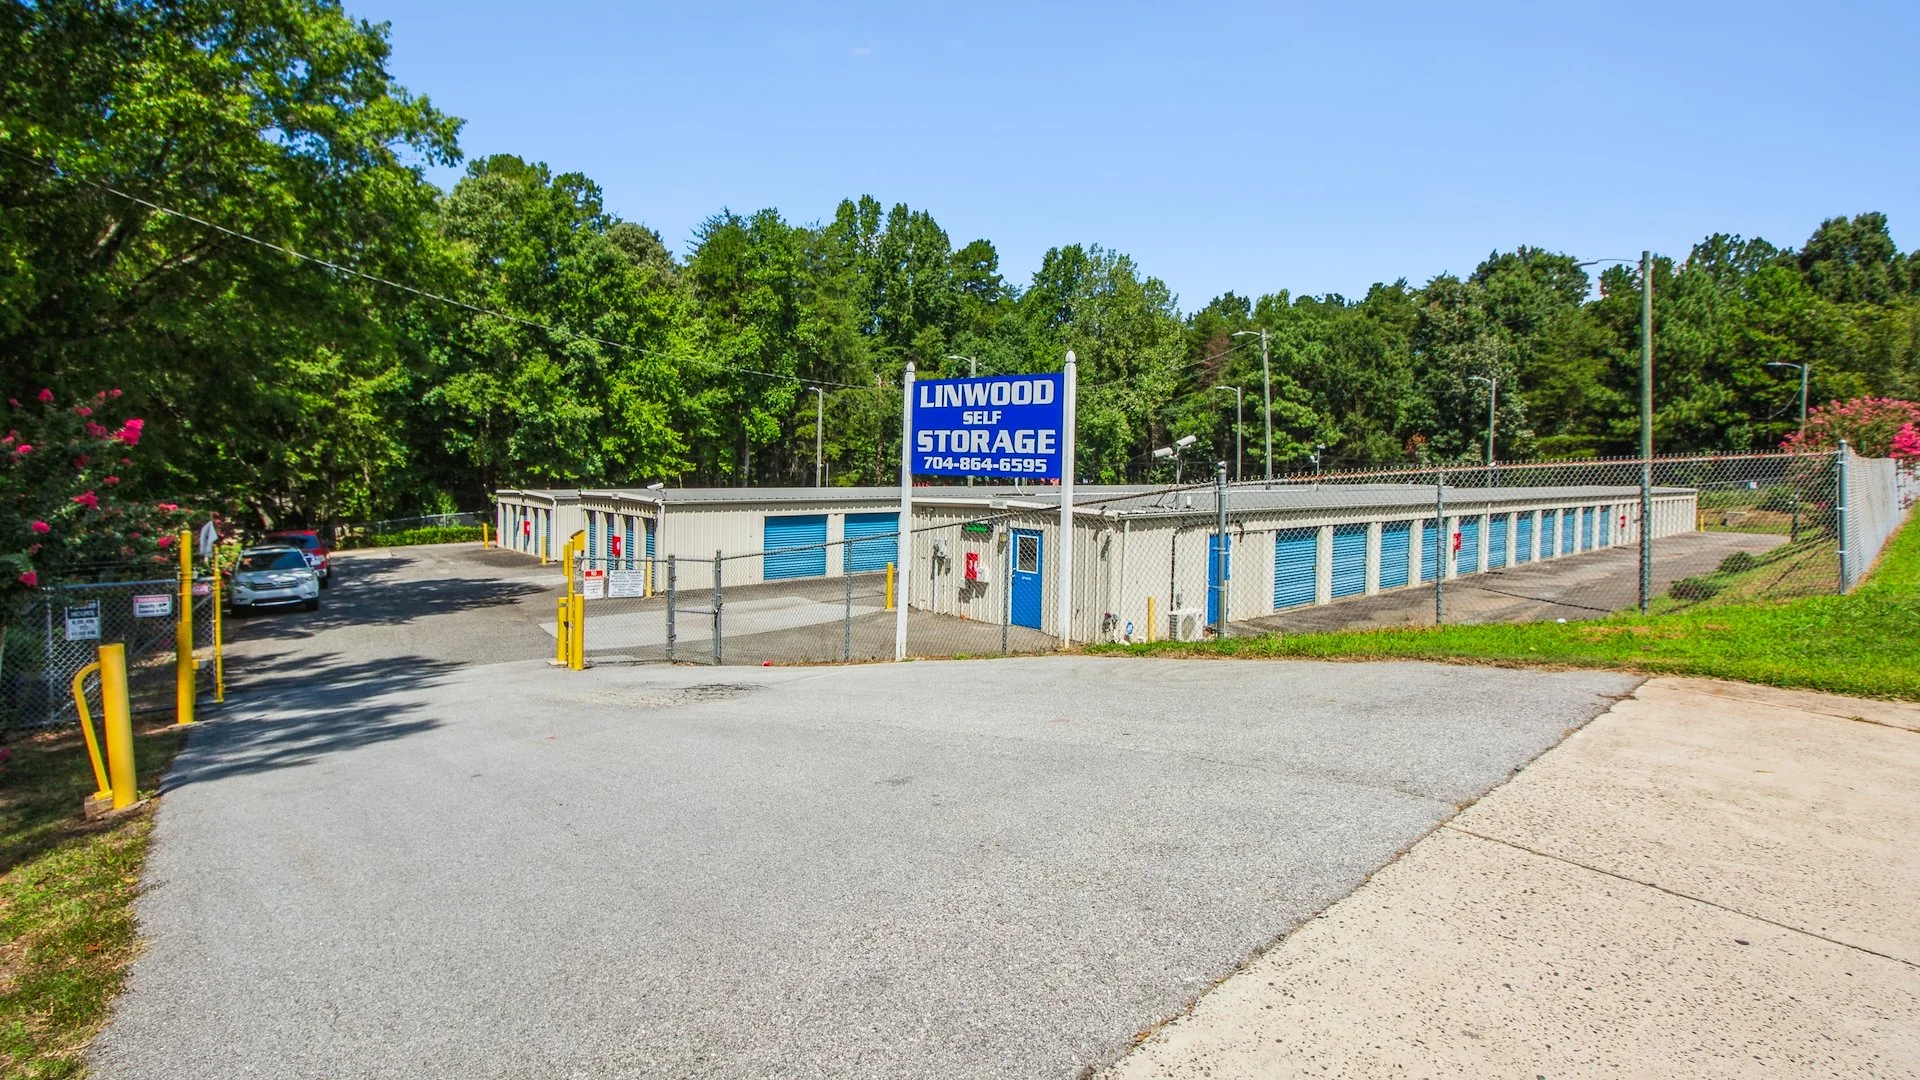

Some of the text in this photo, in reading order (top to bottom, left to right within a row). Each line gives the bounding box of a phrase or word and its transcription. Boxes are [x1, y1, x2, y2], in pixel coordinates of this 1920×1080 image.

[920, 379, 1054, 408] LINWOOD
[962, 410, 1002, 425] SELF
[917, 429, 1056, 454] STORAGE
[923, 456, 1047, 473] 704-864-6595
